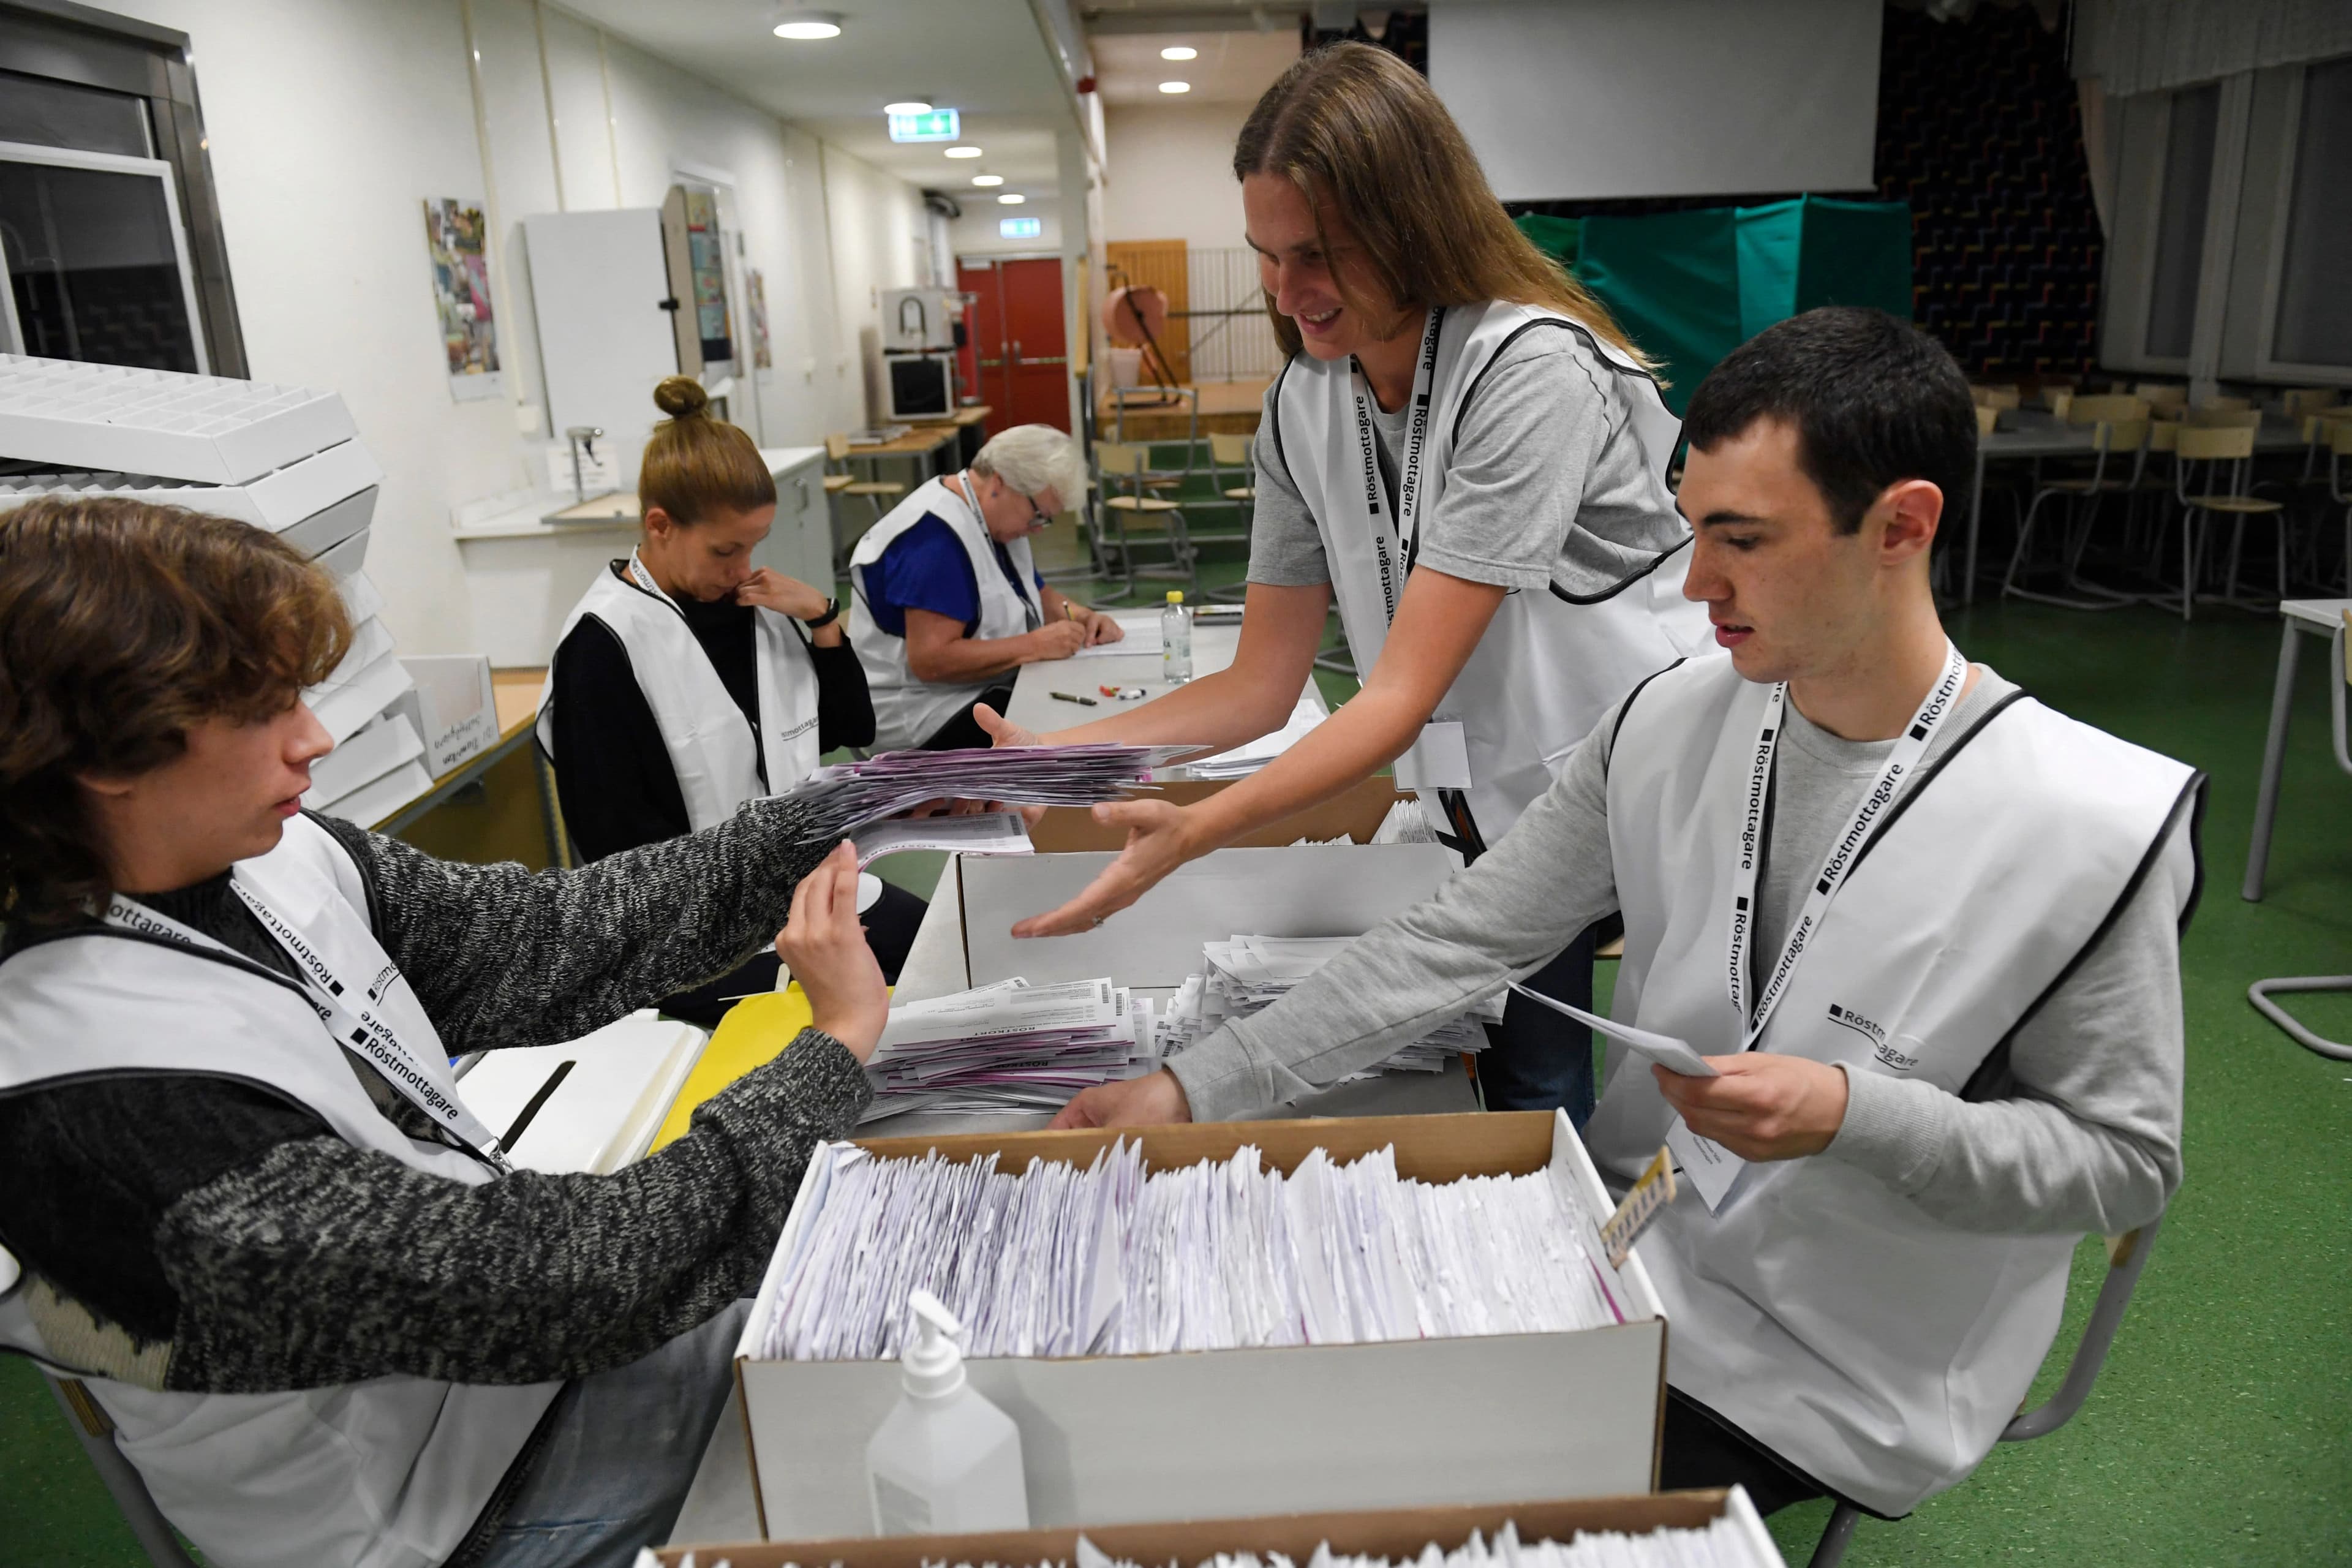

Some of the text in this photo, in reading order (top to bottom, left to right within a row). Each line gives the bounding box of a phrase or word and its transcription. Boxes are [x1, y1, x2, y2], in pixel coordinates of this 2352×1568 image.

[1356, 396, 1379, 500] Röstmottagare
[1403, 408, 1427, 517] Röstmottagare
[1376, 535, 1394, 628] stmottagare
[1920, 646, 1962, 726] Röstmott
[1741, 744, 1770, 870] Röstmottagare
[1824, 763, 1904, 881] Röstmottagare
[1756, 915, 1813, 1020] Röstmottagare
[365, 1036, 459, 1120] Röstmottagare
